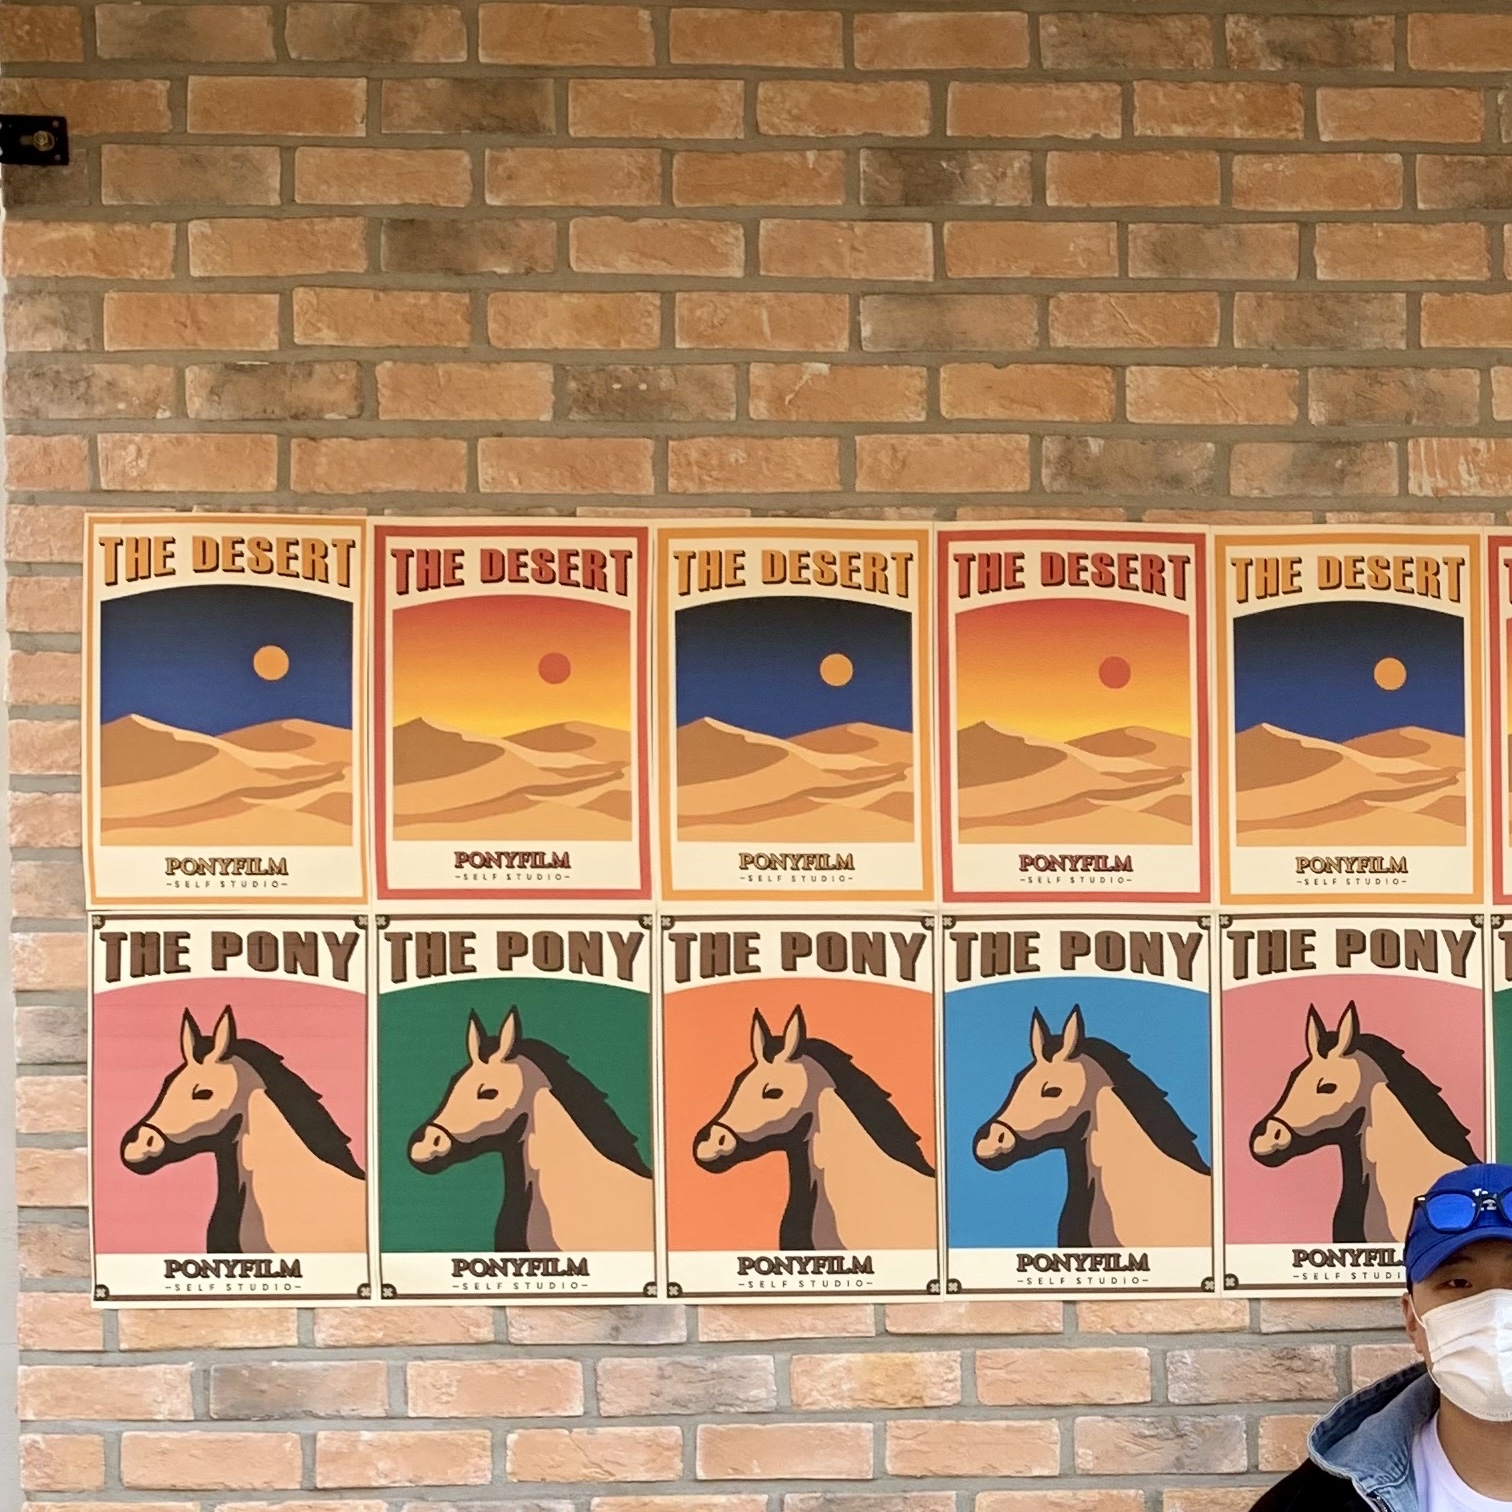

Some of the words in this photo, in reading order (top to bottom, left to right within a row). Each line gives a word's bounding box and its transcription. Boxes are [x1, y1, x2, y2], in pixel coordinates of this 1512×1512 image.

[99, 537, 176, 586] THE
[193, 538, 355, 588] DESERT
[391, 549, 464, 596] THE
[481, 549, 632, 597] DESERT
[674, 550, 746, 596] THE
[763, 551, 913, 598] DESERT
[954, 552, 1025, 599] THE
[1041, 552, 1190, 601] DESERT
[1231, 557, 1302, 604] THE
[1319, 556, 1465, 603] DESERT
[165, 857, 289, 876] PONYFILM
[454, 852, 571, 869] PONYFILM
[739, 853, 855, 870] PONYFILM
[1019, 855, 1133, 872] PONYFILM
[1296, 856, 1408, 874] PONYFILM
[100, 932, 191, 983] THE
[212, 931, 360, 982] PONY
[384, 932, 477, 984] THE
[497, 931, 644, 982] PONY
[669, 932, 761, 983] THE
[781, 932, 926, 982] PONY
[950, 931, 1040, 982] THE
[1060, 931, 1203, 981] PONY
[1227, 929, 1316, 981] THE
[1336, 929, 1476, 978] PONY
[737, 1256, 874, 1275] PONYFILM
[1017, 1253, 1150, 1272] PONYFILM
[1292, 1248, 1404, 1267] PONYFIL
[164, 1259, 303, 1278] PONYFILM
[452, 1258, 590, 1277] PONYFILM
[1350, 1271, 1401, 1280] STUDI
